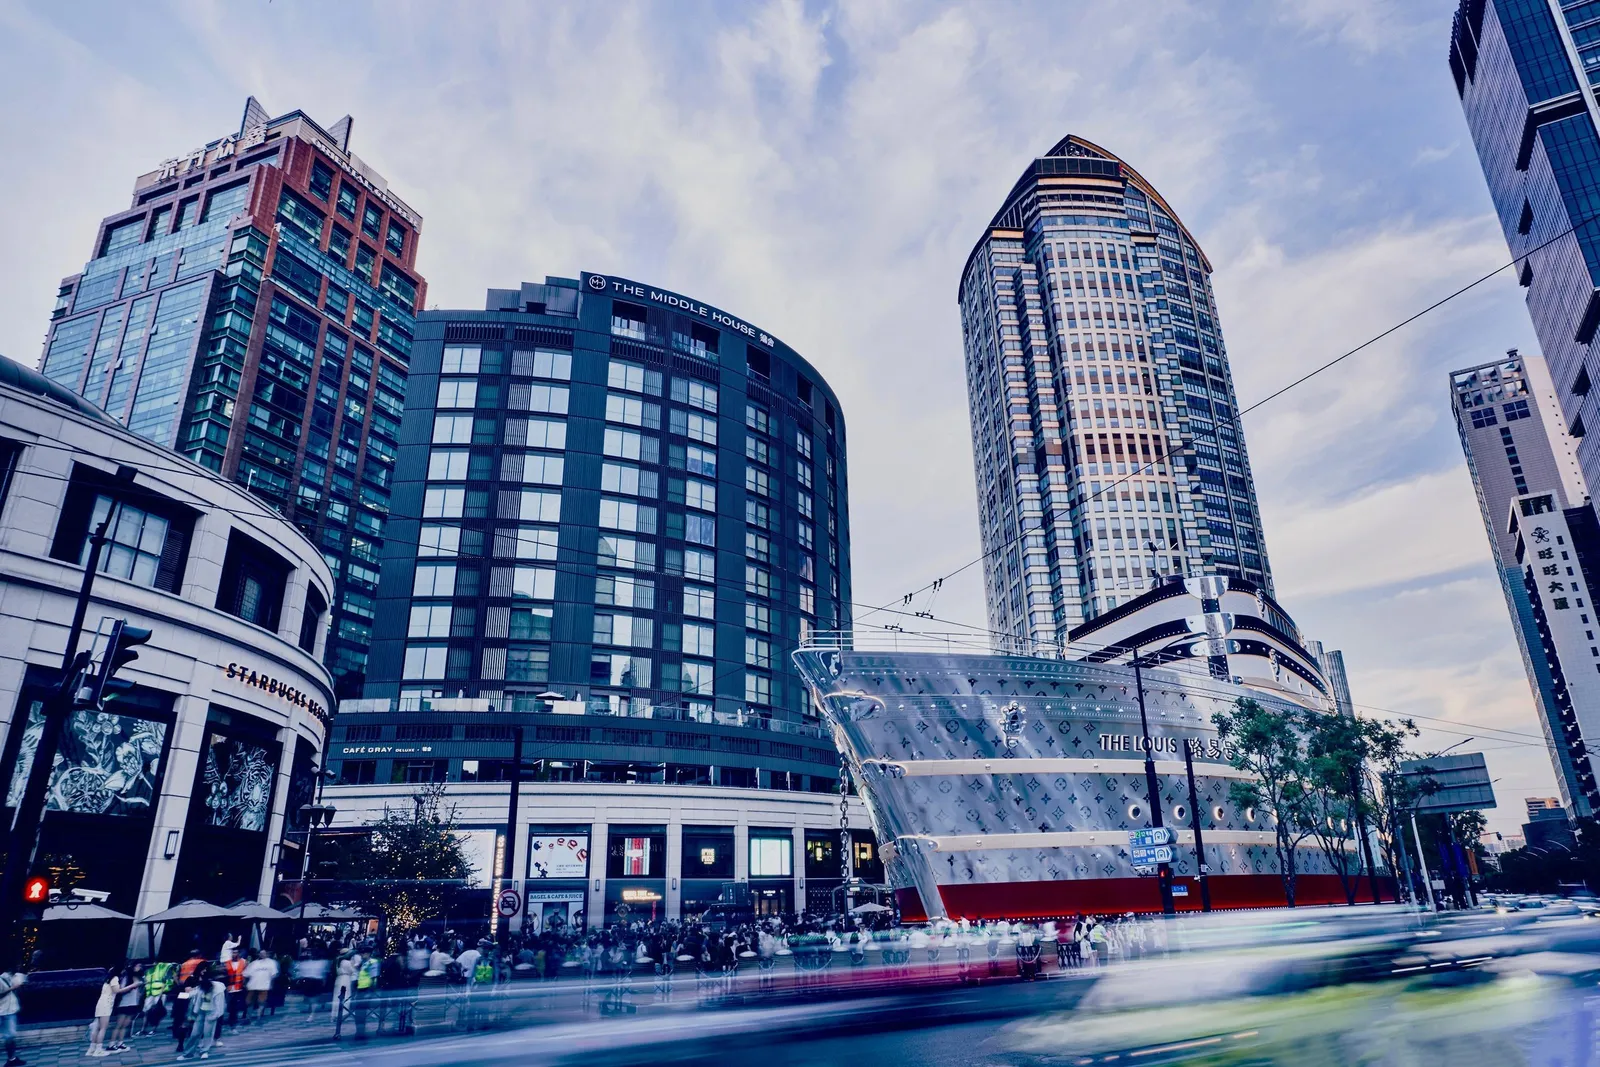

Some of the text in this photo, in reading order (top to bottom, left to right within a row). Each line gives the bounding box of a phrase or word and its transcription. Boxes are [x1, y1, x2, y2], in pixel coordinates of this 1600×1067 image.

[612, 281, 645, 297] THE
[650, 291, 708, 317] MIDDLE
[712, 312, 757, 338] HOUSE
[226, 662, 307, 708] STARBUCKS
[342, 746, 365, 754] CAFÉ
[1099, 733, 1130, 751] THE
[1133, 734, 1178, 753] LOUIS
[495, 848, 504, 877] WATCH
